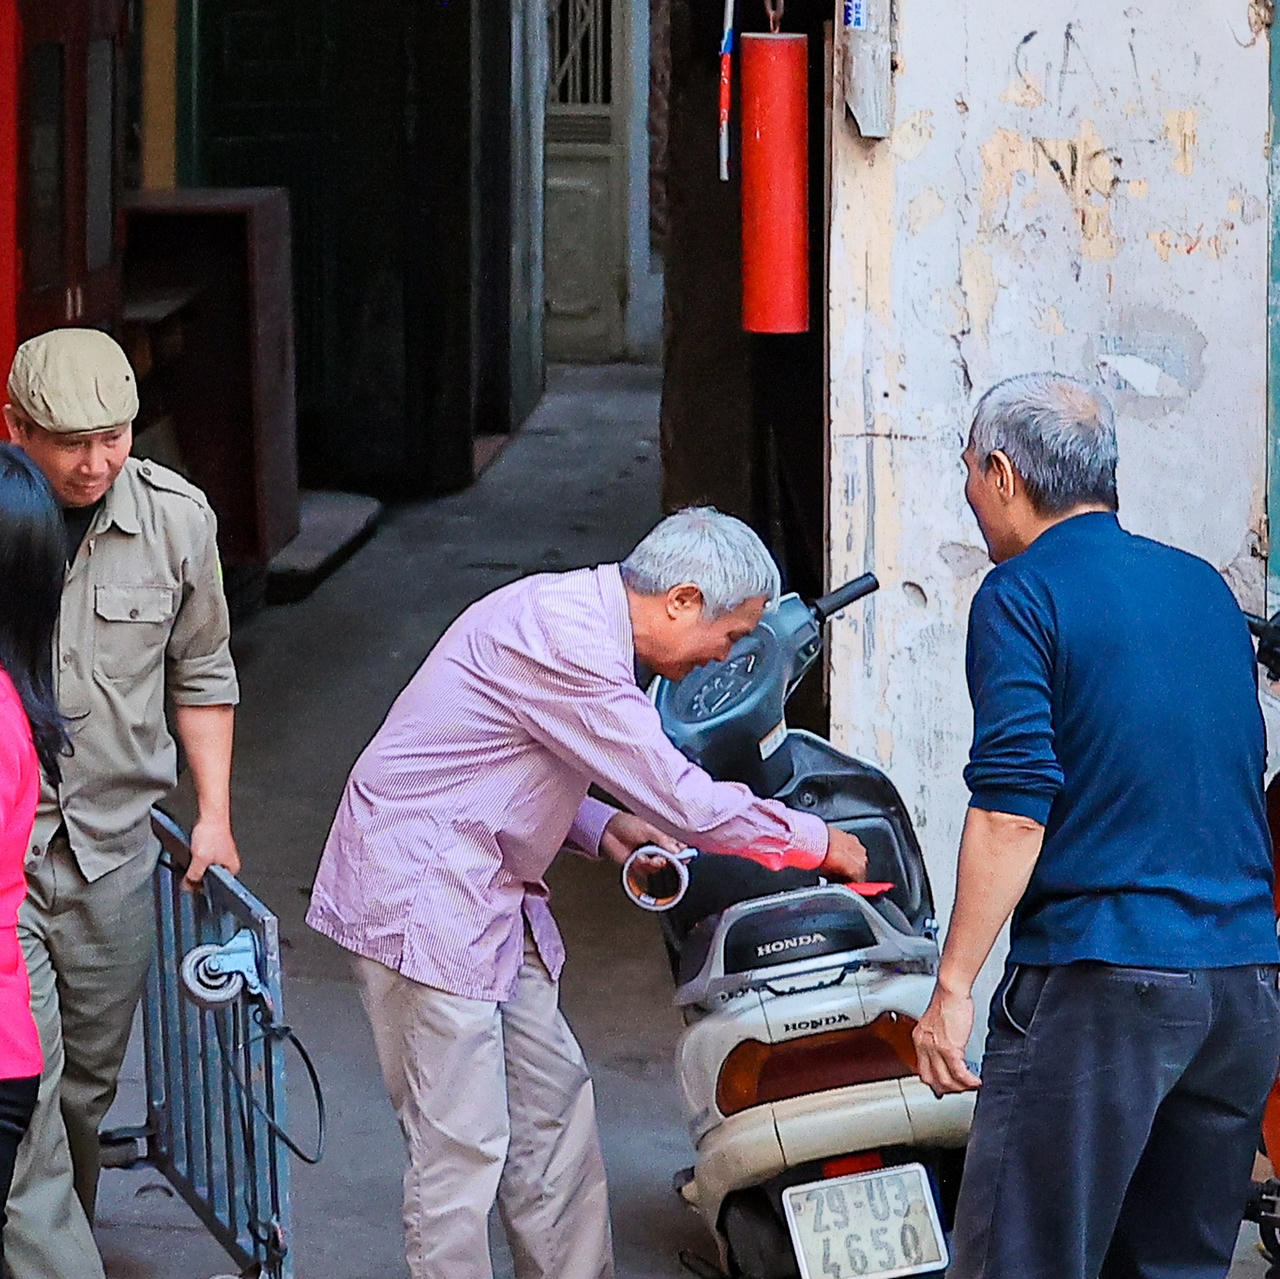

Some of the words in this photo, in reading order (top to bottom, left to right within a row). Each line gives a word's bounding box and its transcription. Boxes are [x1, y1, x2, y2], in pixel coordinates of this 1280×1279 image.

[757, 932, 827, 957] HONDA
[783, 1013, 850, 1032] HONDA
[822, 1223, 923, 1279] 4650
